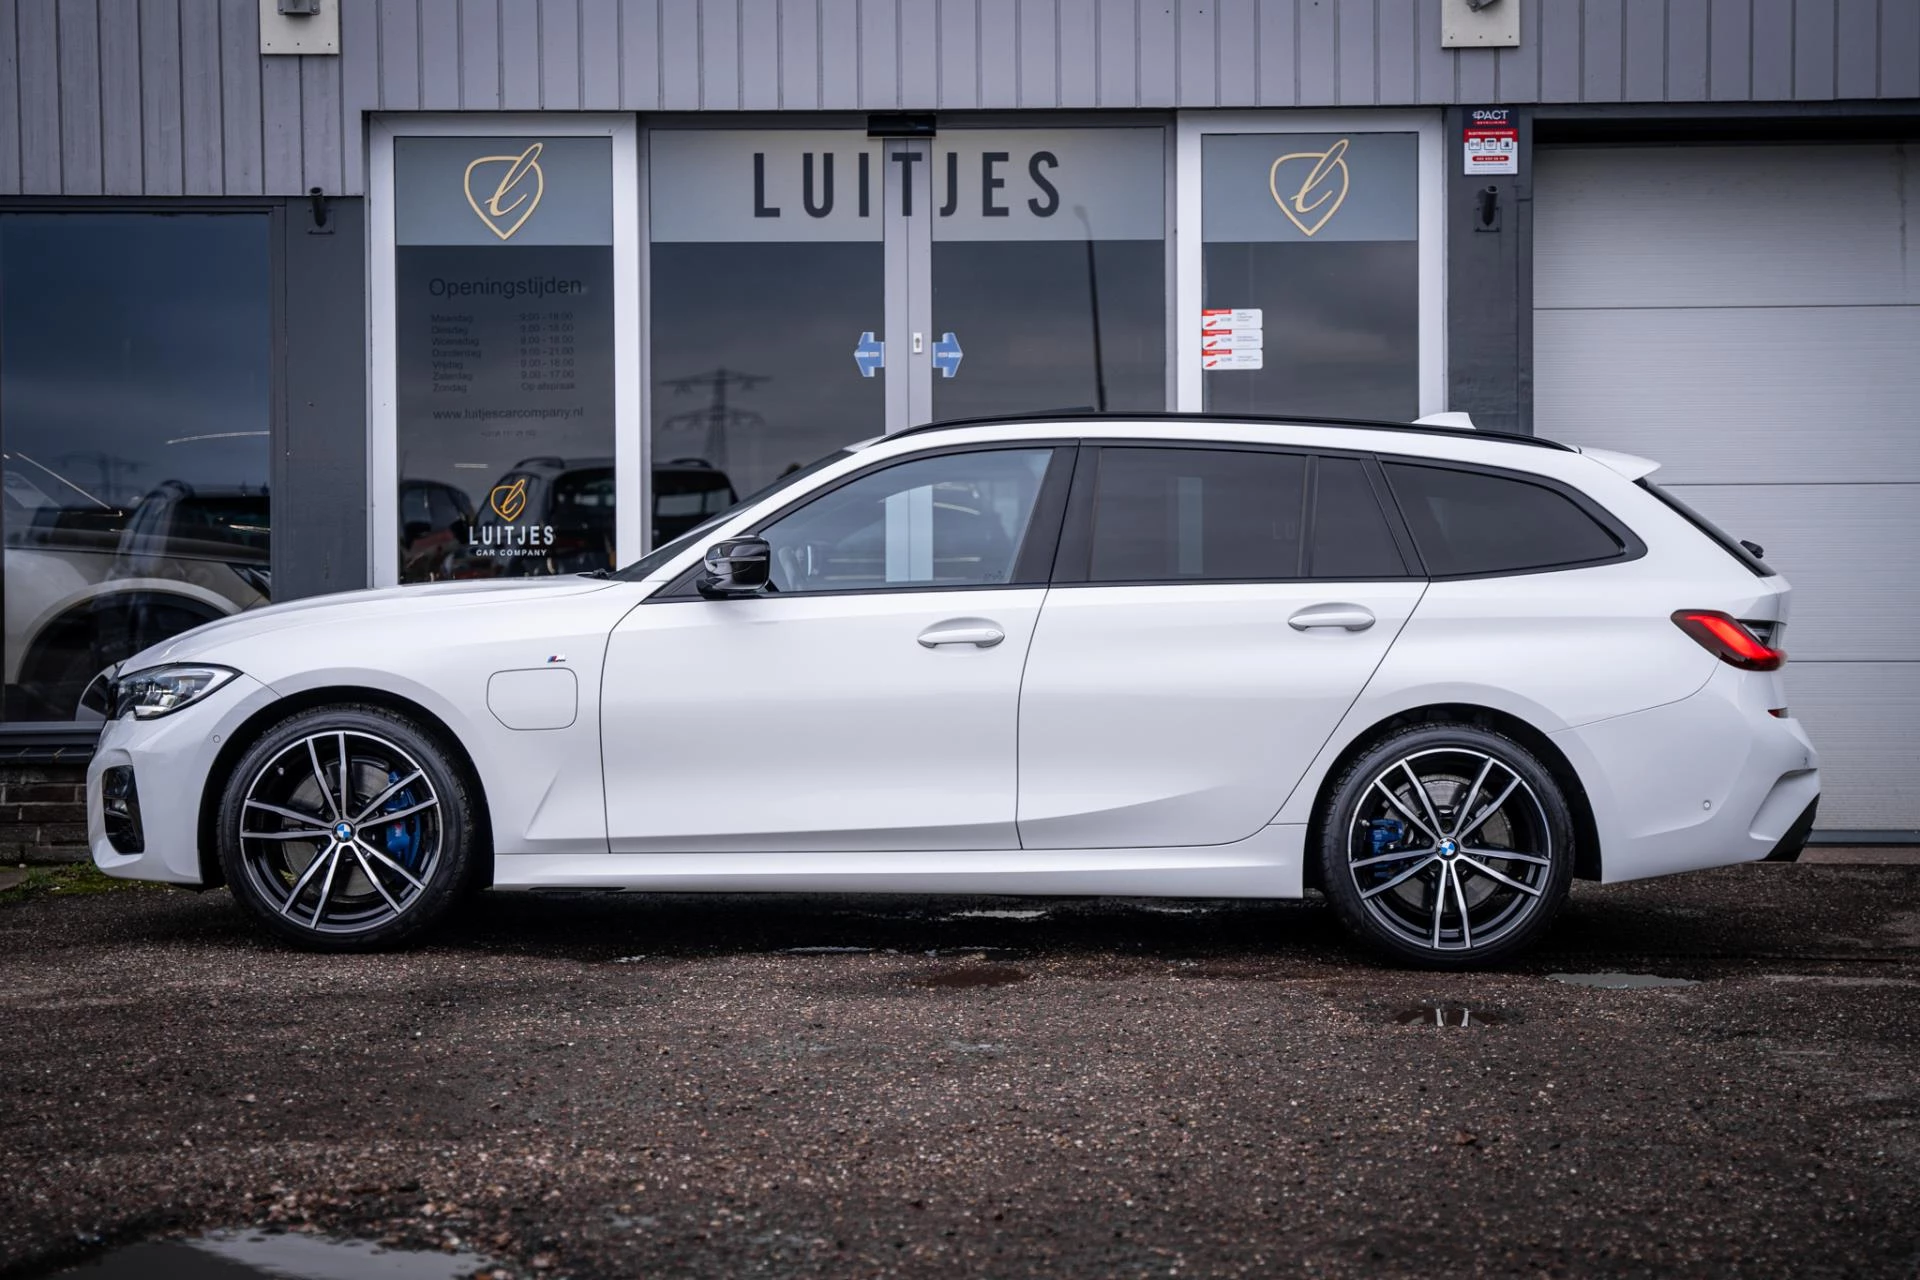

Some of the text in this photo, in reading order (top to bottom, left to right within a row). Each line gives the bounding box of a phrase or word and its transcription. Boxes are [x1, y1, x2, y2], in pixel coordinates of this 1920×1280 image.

[754, 151, 1059, 218] LUITJES
[429, 276, 582, 299] Openingstijden
[432, 383, 467, 394] Zondag
[432, 407, 584, 421] www.luitjescarcompany.nl
[469, 526, 554, 545] LUITJES
[476, 549, 548, 557] CAR COMPANY
